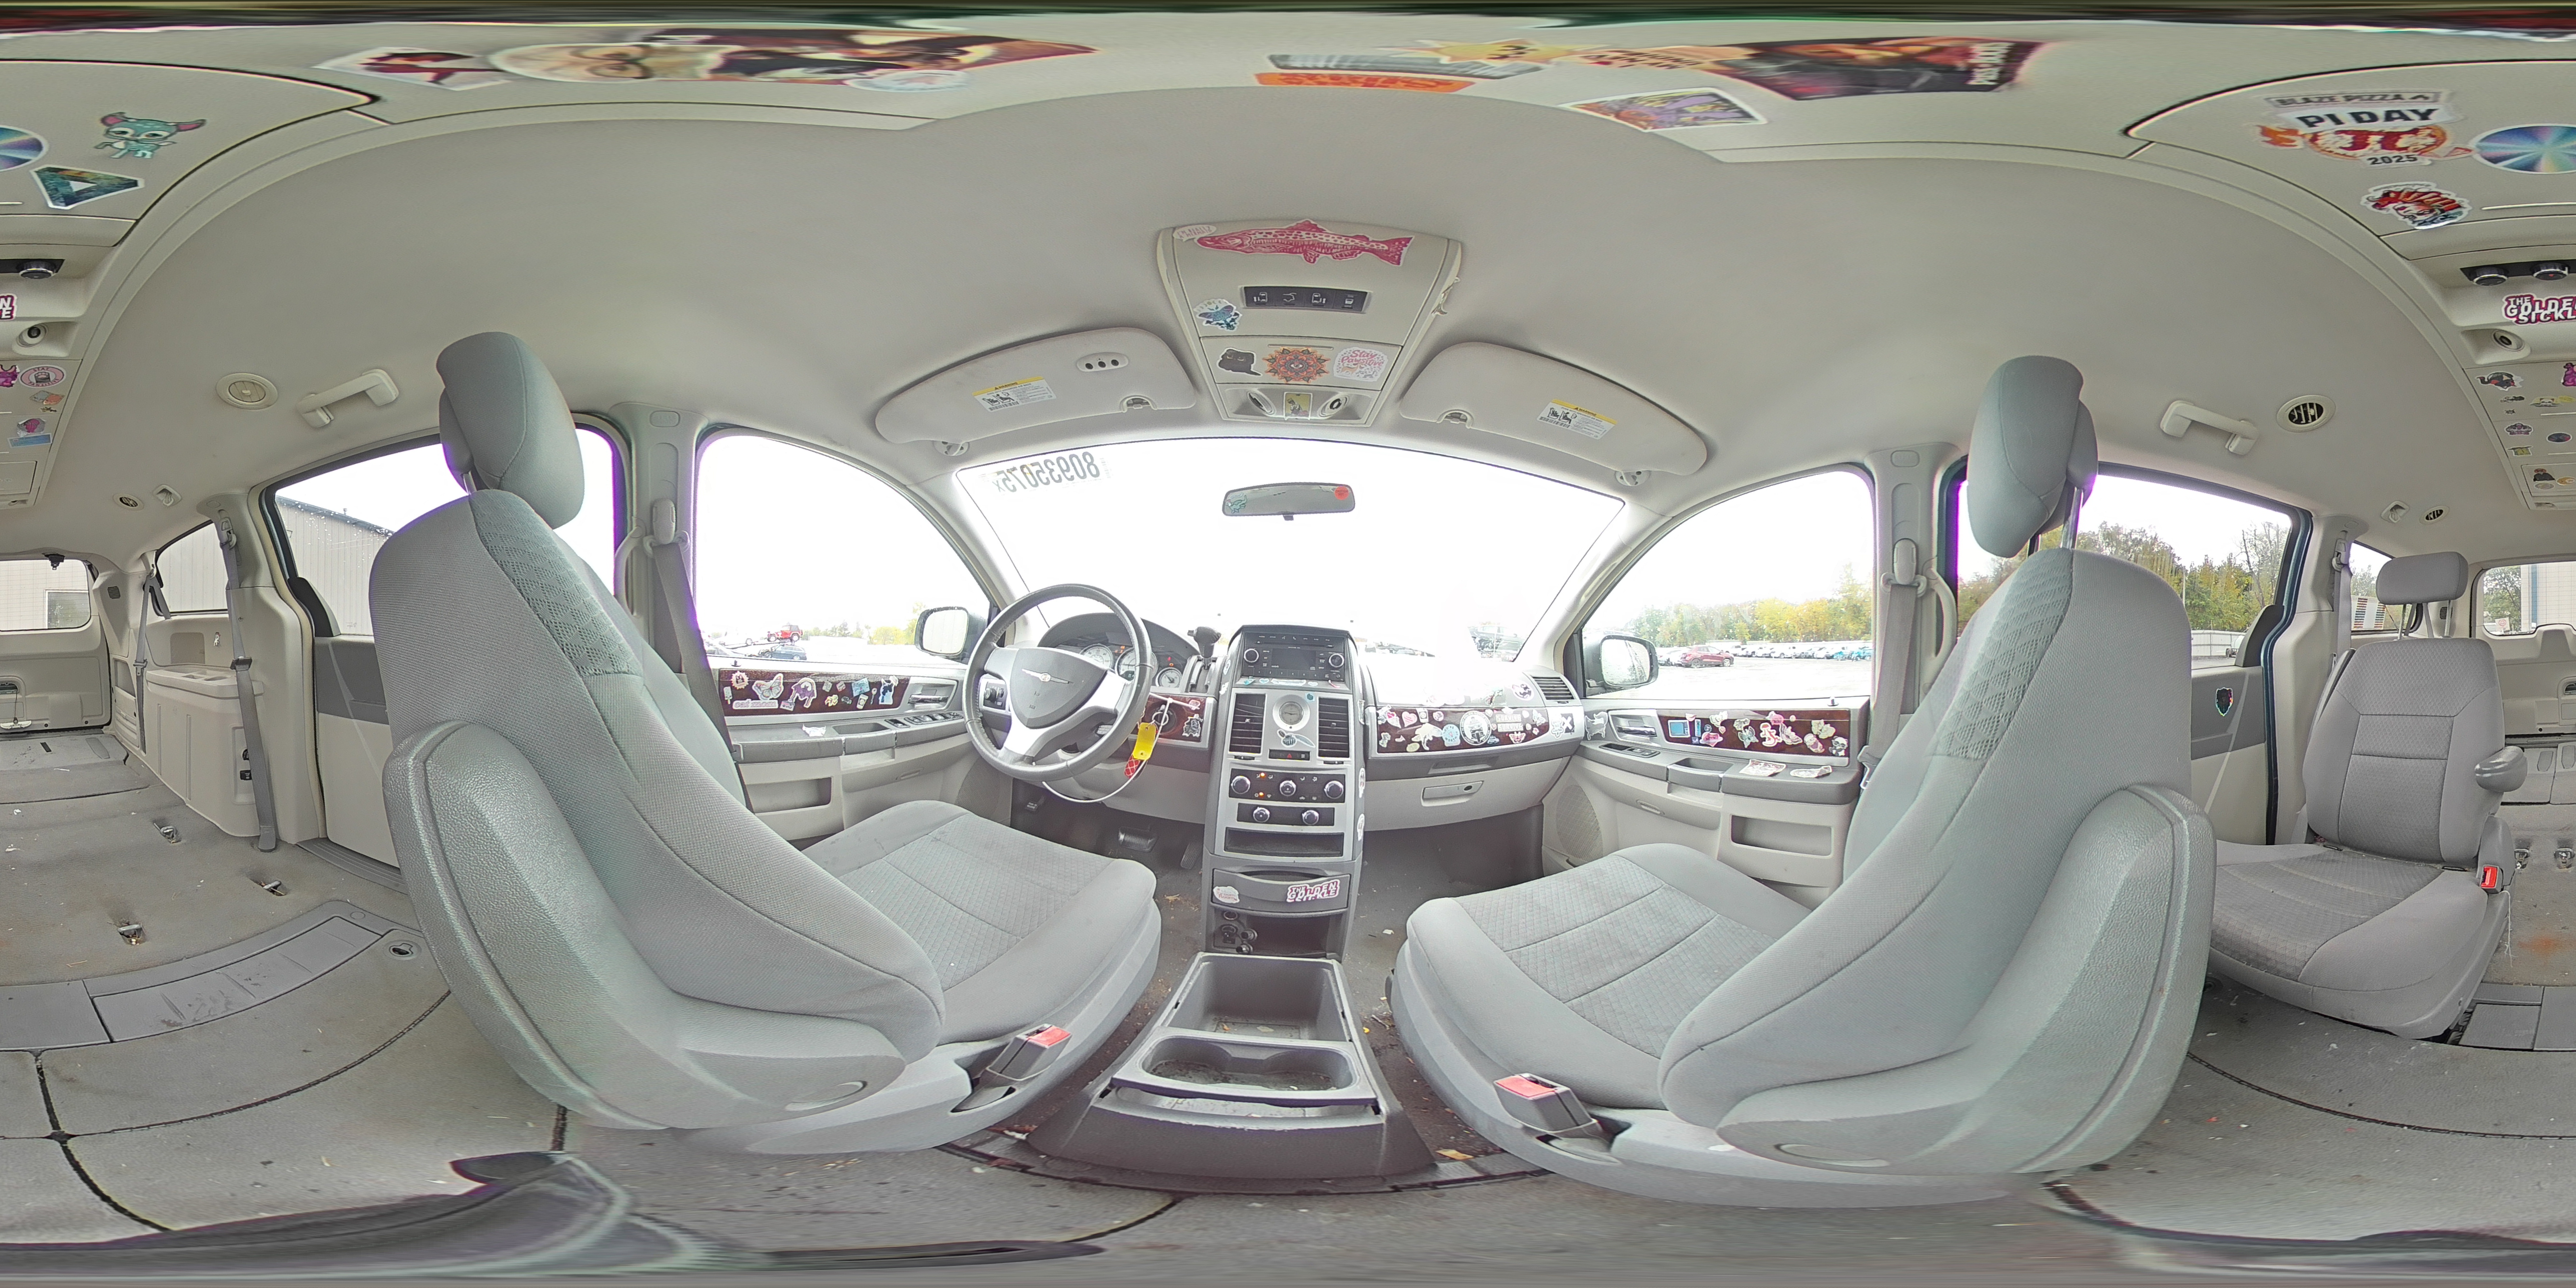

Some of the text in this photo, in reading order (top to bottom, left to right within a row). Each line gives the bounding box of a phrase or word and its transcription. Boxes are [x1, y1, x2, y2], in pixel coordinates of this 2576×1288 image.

[2296, 109, 2439, 127] PI DAY
[2367, 154, 2418, 165] 2025
[2507, 297, 2531, 306] THE
[2507, 299, 2576, 317] GOLDE
[1350, 349, 1378, 359] Stay
[1341, 356, 1384, 366] Pawsitive
[1578, 408, 1597, 417] WARNING
[1289, 882, 1337, 899] GOLDEN
